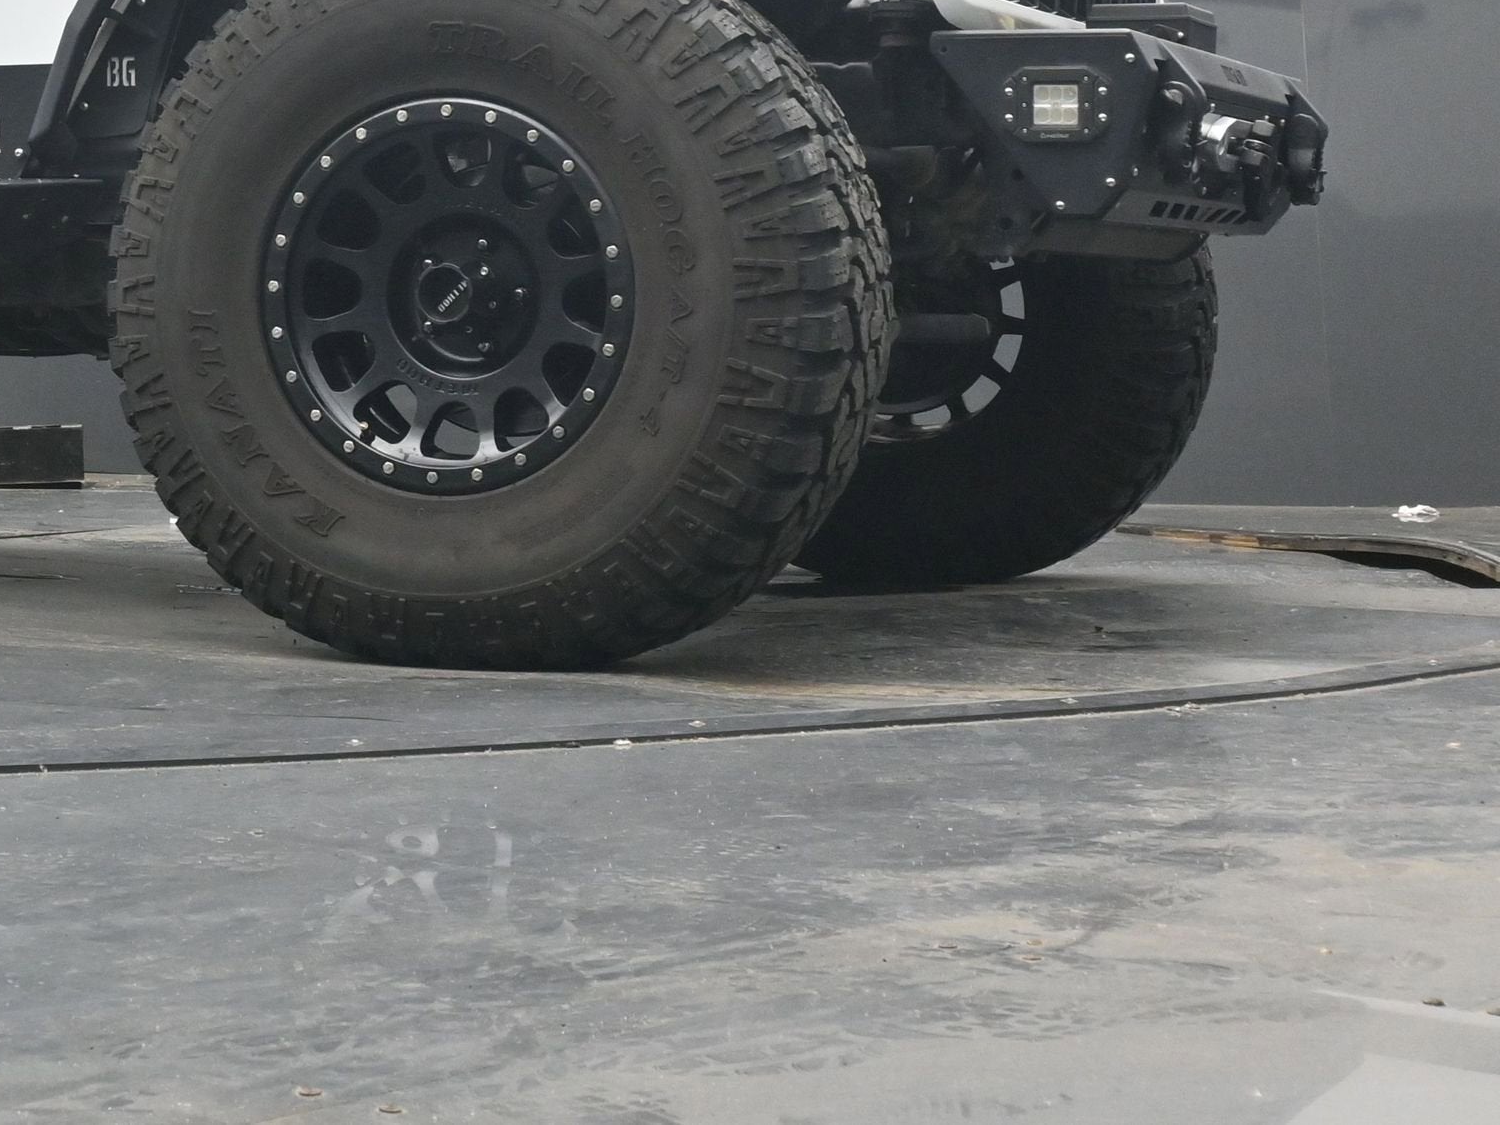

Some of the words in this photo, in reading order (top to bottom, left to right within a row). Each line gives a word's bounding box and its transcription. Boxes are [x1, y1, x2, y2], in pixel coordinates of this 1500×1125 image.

[106, 56, 137, 87] BG
[428, 20, 616, 127] TRAIL
[619, 132, 695, 275] HOG
[188, 309, 346, 537] KANATI
